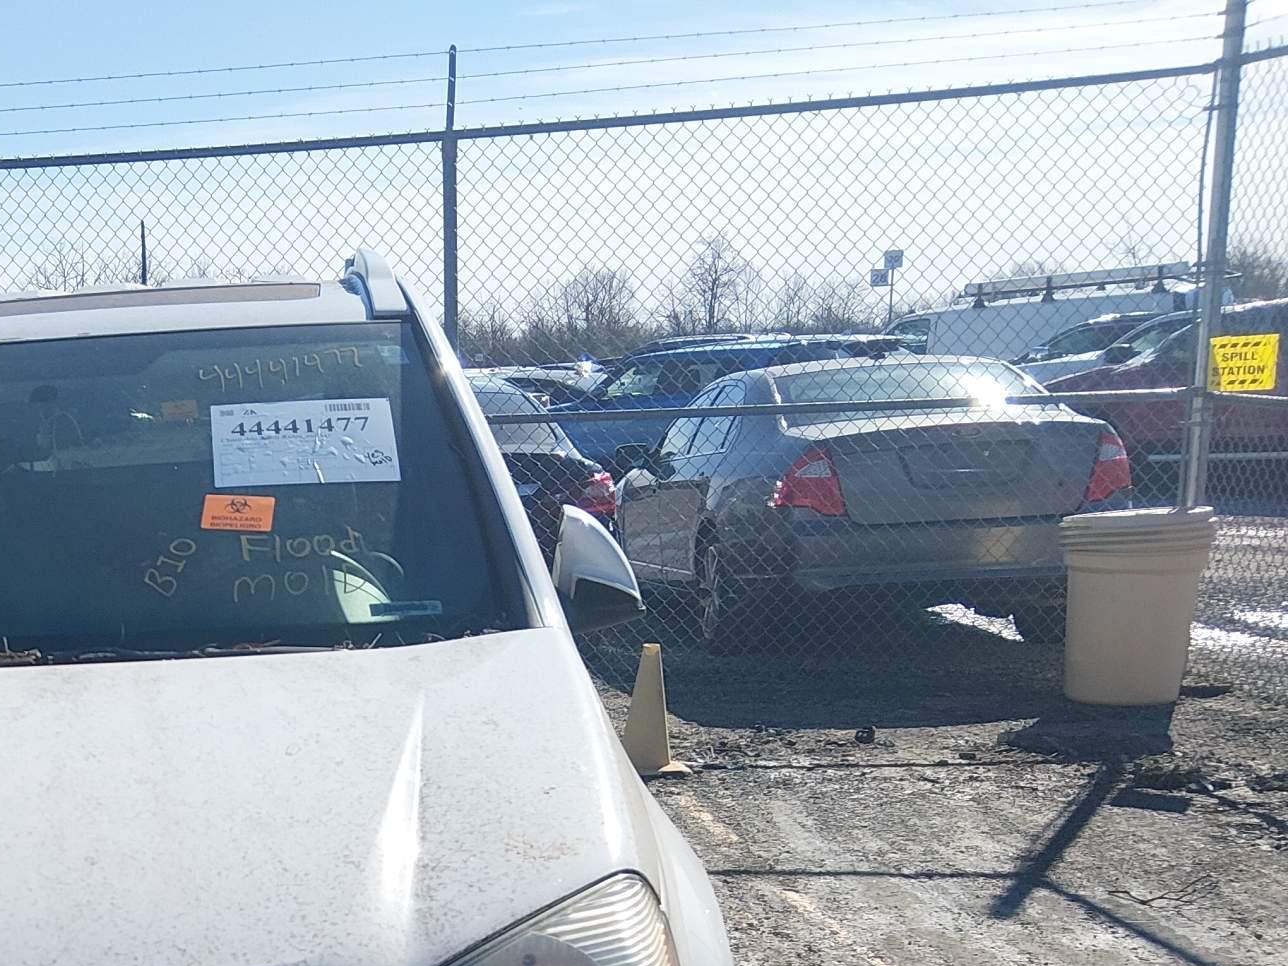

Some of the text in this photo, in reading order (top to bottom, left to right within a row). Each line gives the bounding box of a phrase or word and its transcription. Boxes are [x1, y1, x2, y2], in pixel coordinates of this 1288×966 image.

[1221, 351, 1258, 362] SPILL
[198, 346, 362, 393] 44441477
[1211, 364, 1265, 377] STATION
[231, 416, 370, 436] 44441477
[143, 537, 197, 598] BIO
